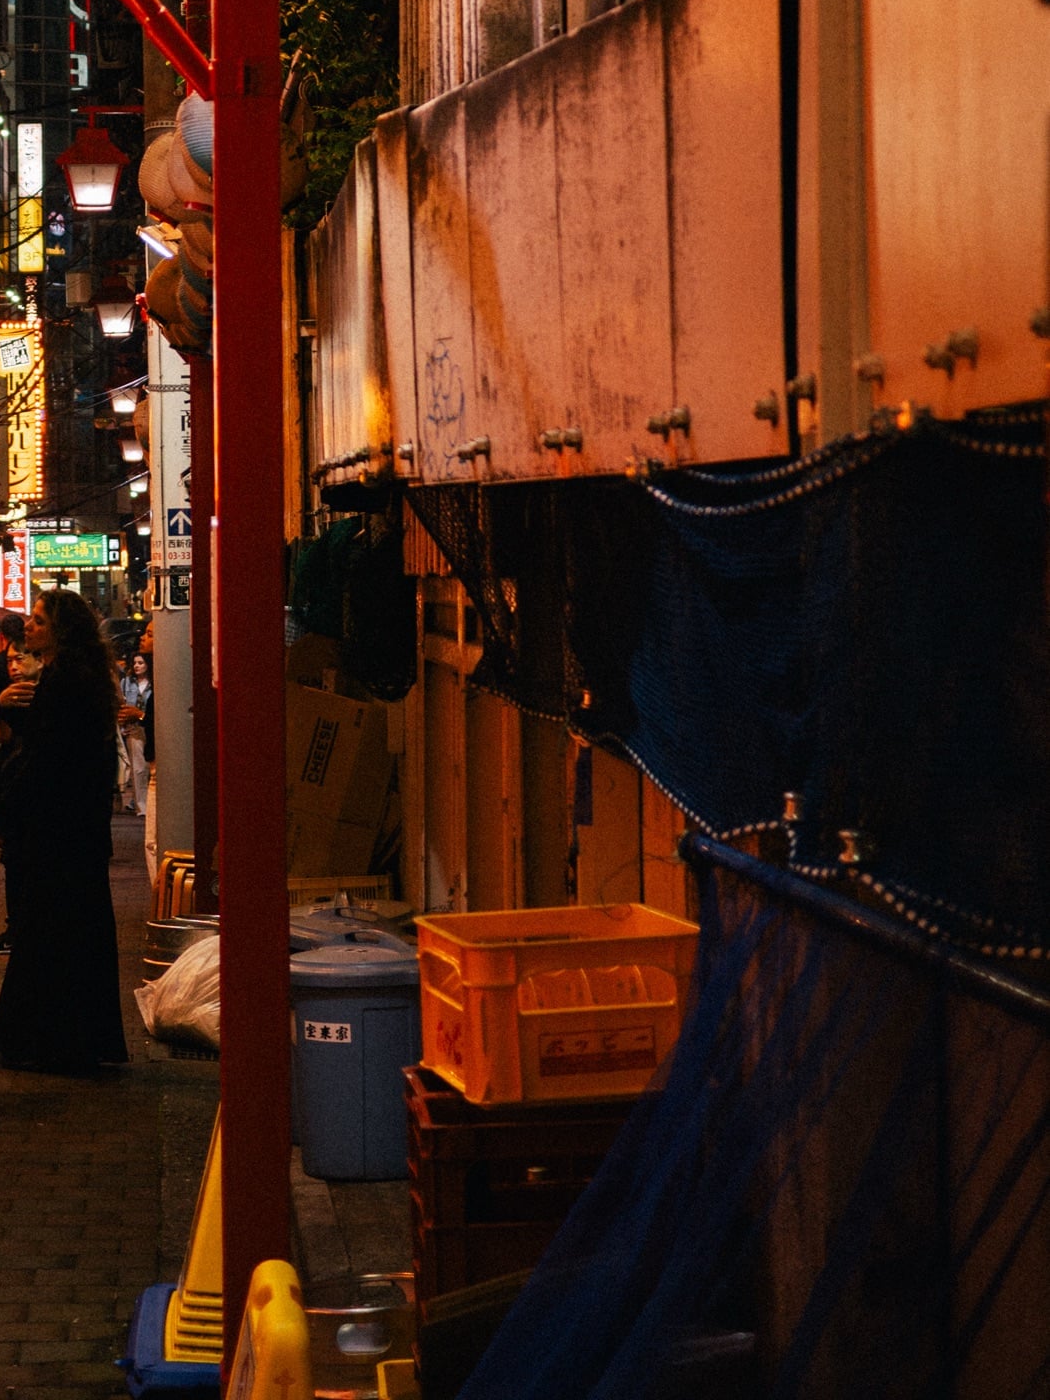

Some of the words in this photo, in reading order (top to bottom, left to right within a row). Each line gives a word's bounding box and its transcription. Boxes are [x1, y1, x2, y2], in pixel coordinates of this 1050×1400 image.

[35, 540, 102, 560] 思い出横丁
[307, 720, 332, 783] CHEESE
